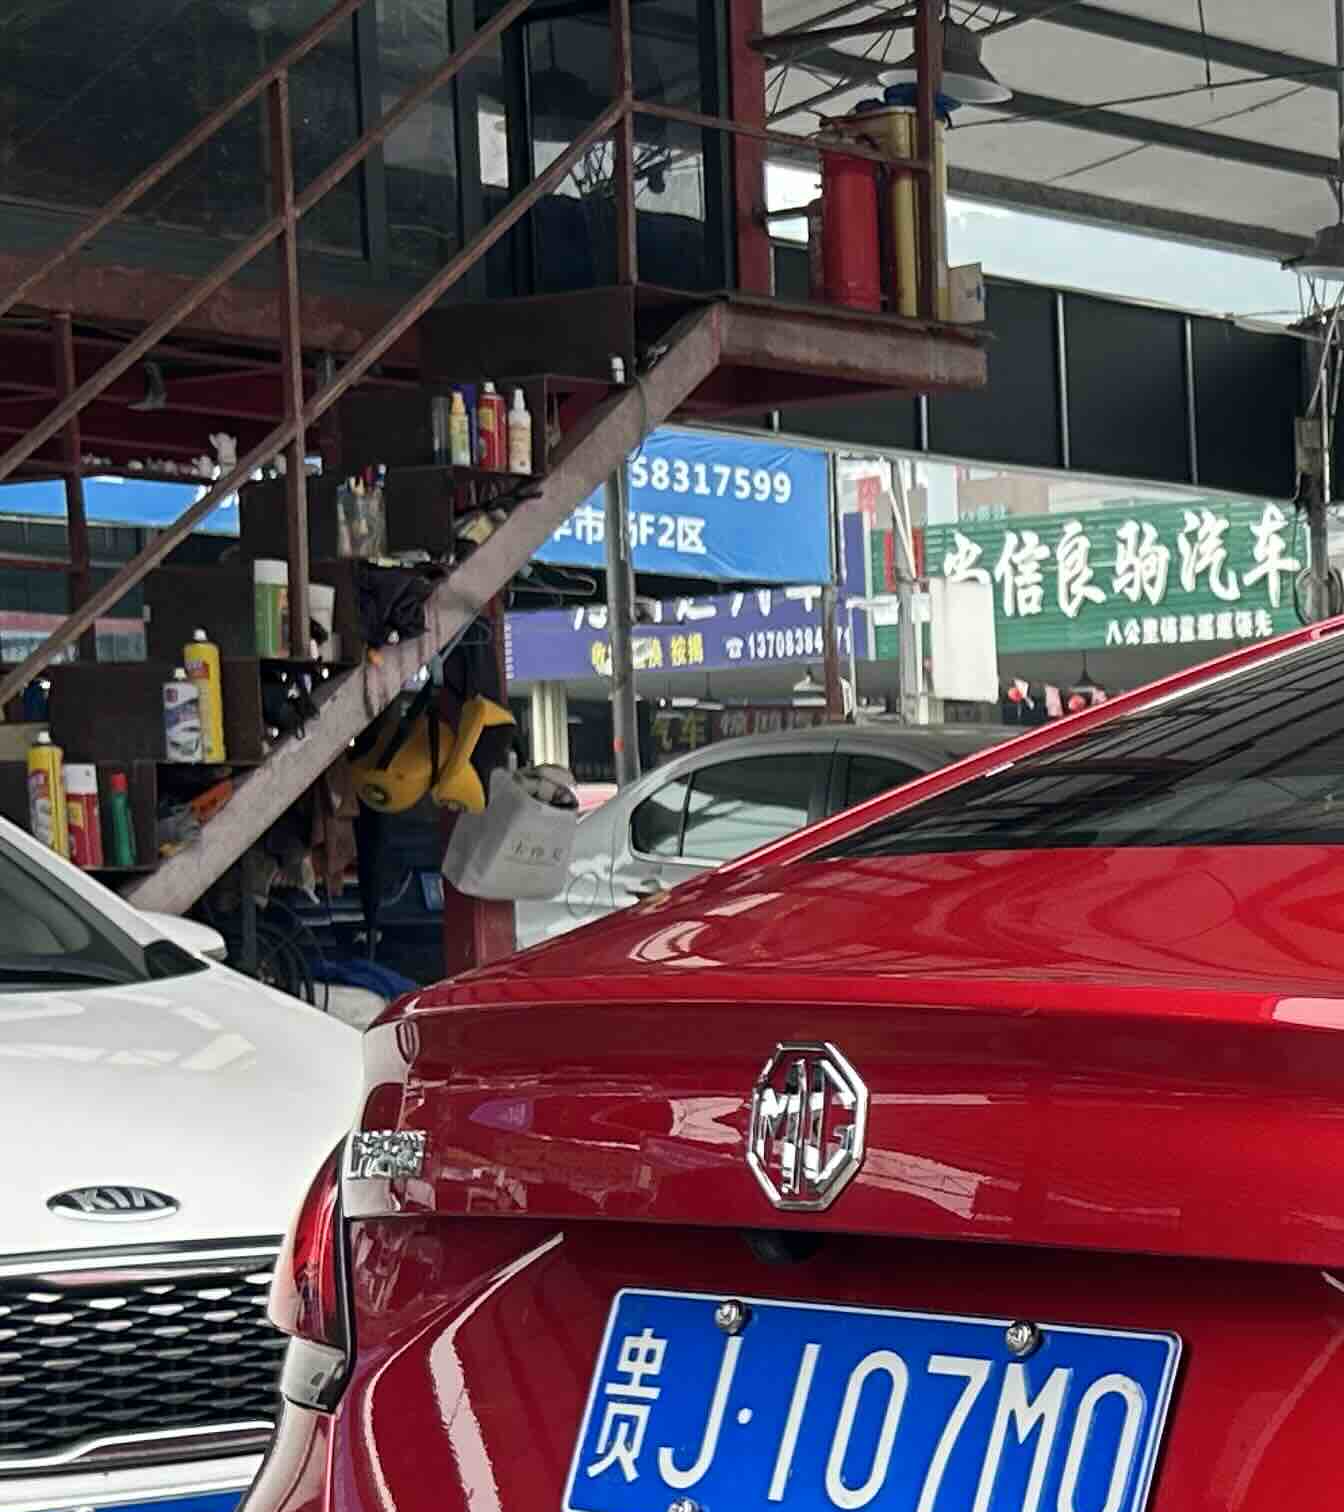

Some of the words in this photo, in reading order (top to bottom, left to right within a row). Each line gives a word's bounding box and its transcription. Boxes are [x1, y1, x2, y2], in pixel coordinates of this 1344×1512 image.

[630, 455, 793, 504] 58317599
[749, 1052, 864, 1202] MG
[66, 1186, 169, 1213] KIA
